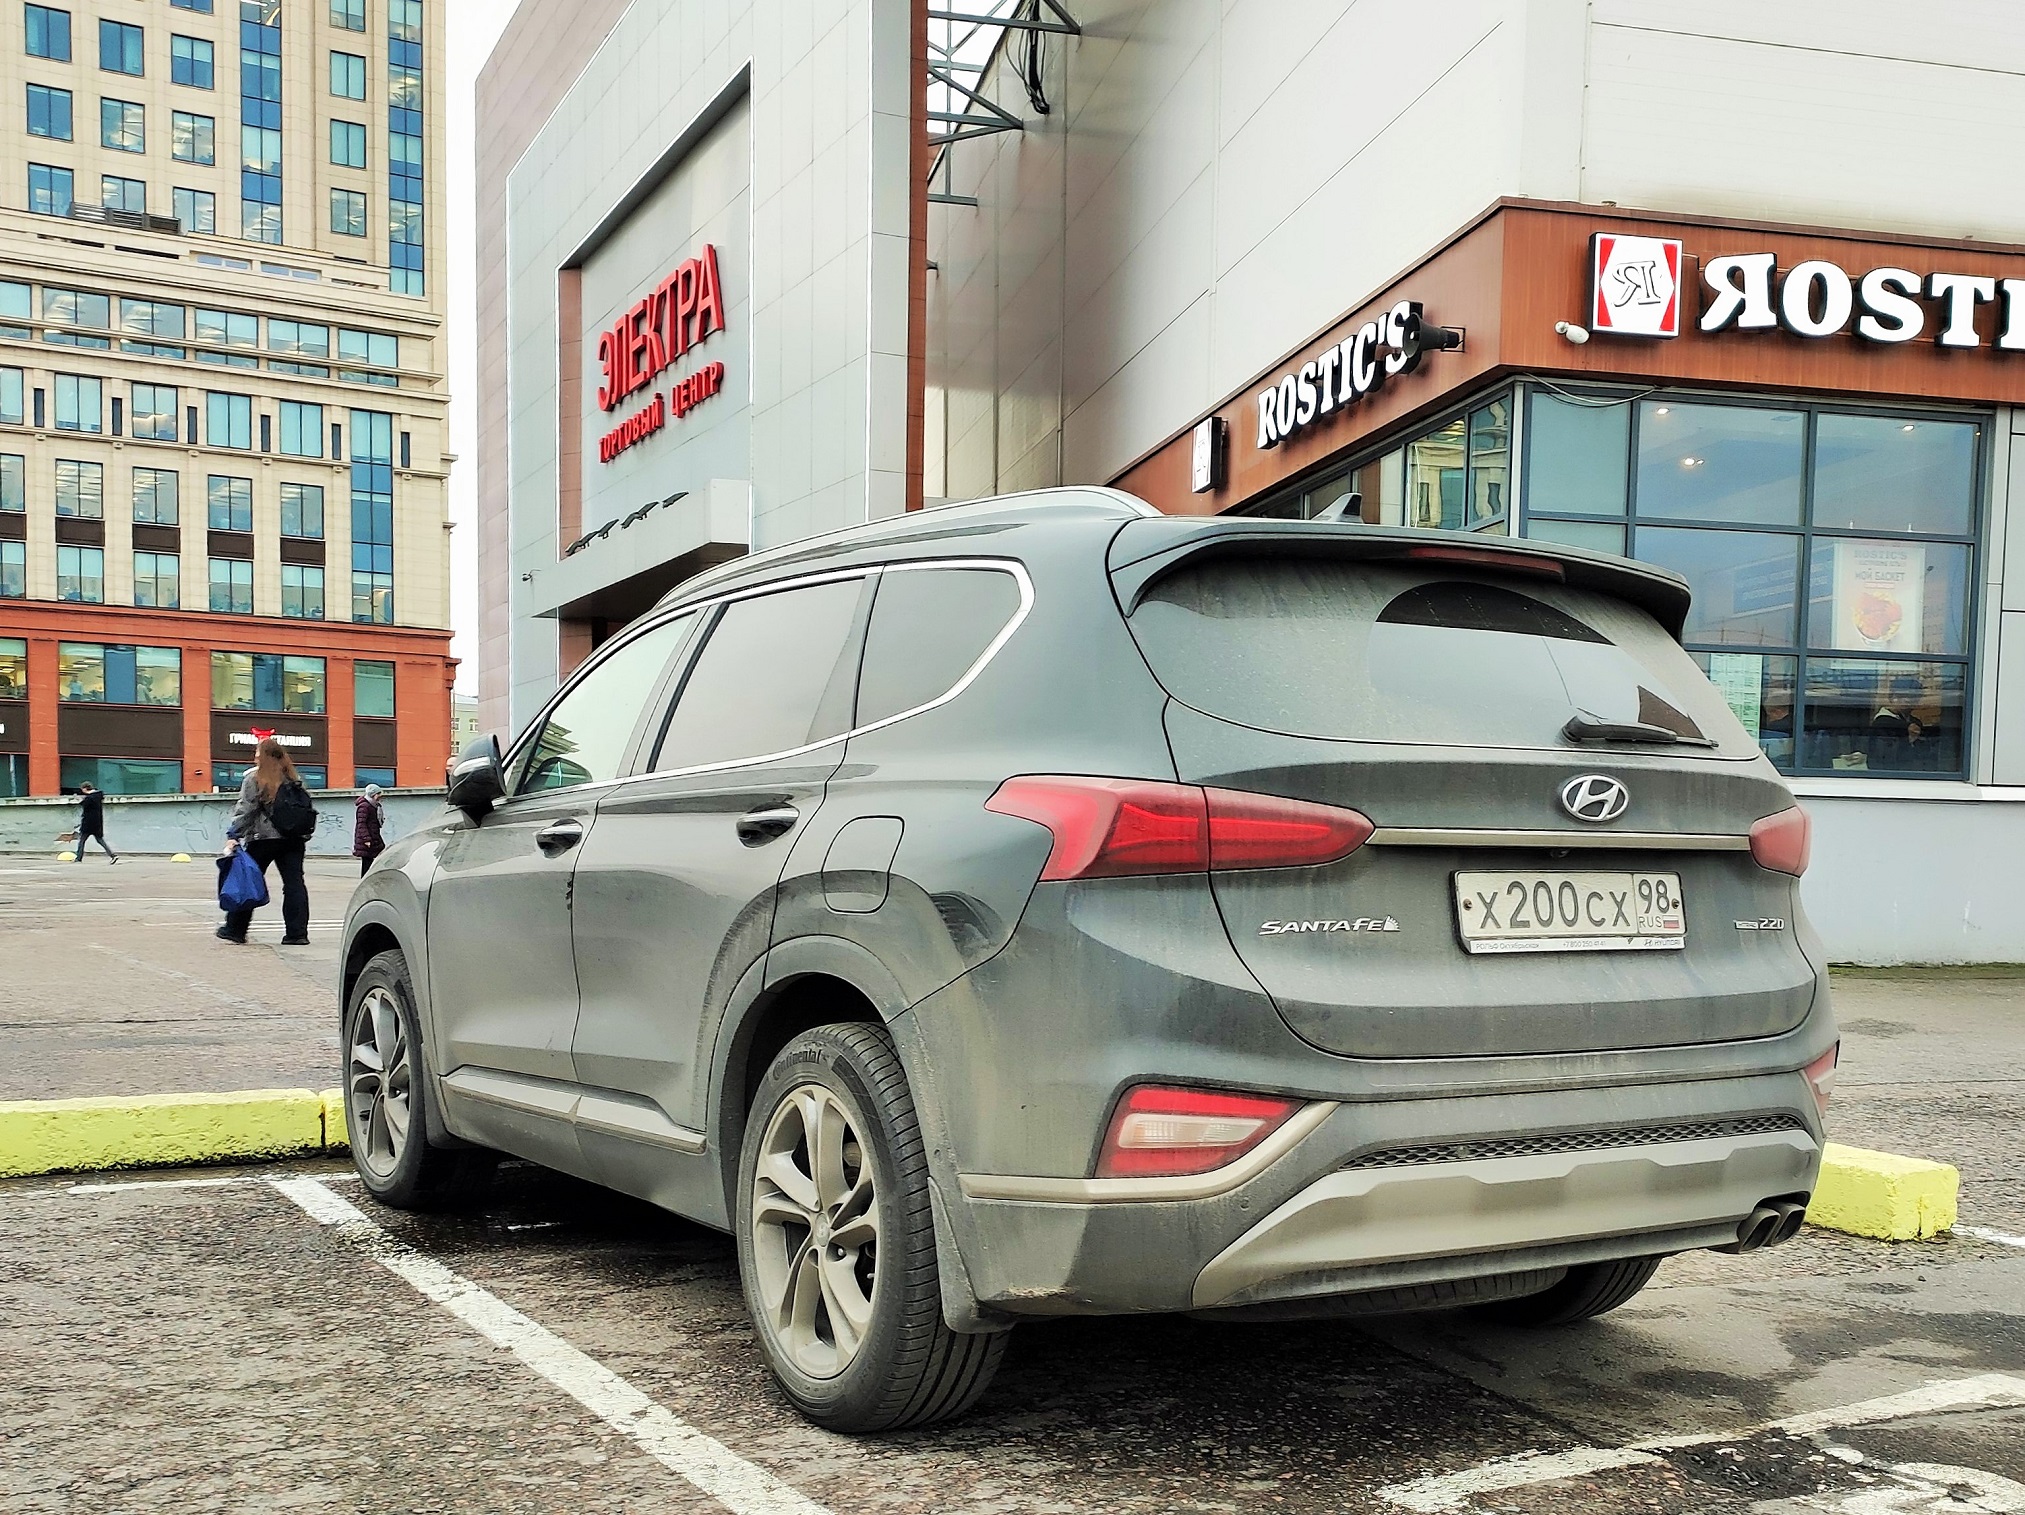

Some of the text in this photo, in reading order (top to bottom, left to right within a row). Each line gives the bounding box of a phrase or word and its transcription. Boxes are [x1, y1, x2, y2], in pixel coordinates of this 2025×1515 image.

[597, 244, 725, 411] ЭЛЕКТРА
[1257, 300, 1423, 449] ROSTIC'S
[599, 360, 724, 463] ТОРГОВЫЙ ЦЕНТР
[1638, 878, 1670, 914] 98
[1638, 916, 1662, 928] RUS
[772, 1049, 823, 1081] Continental
